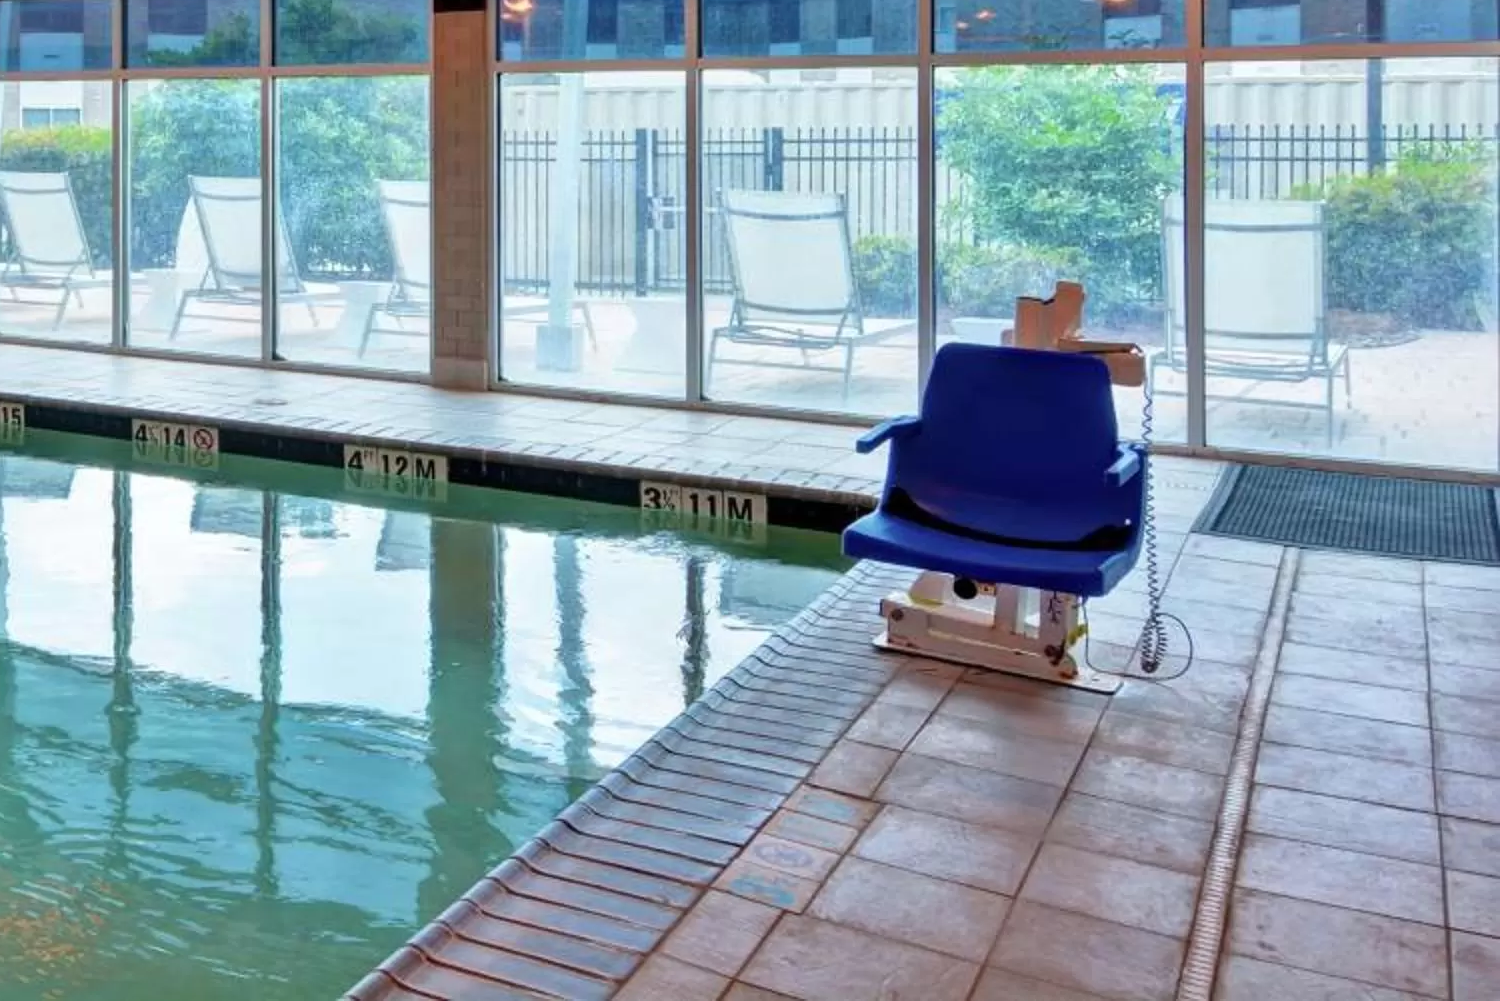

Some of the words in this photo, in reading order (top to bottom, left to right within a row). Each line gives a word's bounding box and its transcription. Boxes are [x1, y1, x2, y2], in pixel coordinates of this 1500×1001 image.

[2, 406, 21, 424] 15
[164, 426, 186, 447] 14
[381, 454, 409, 476] 12
[415, 458, 436, 480] M
[689, 492, 717, 518] 11
[727, 497, 753, 522] M
